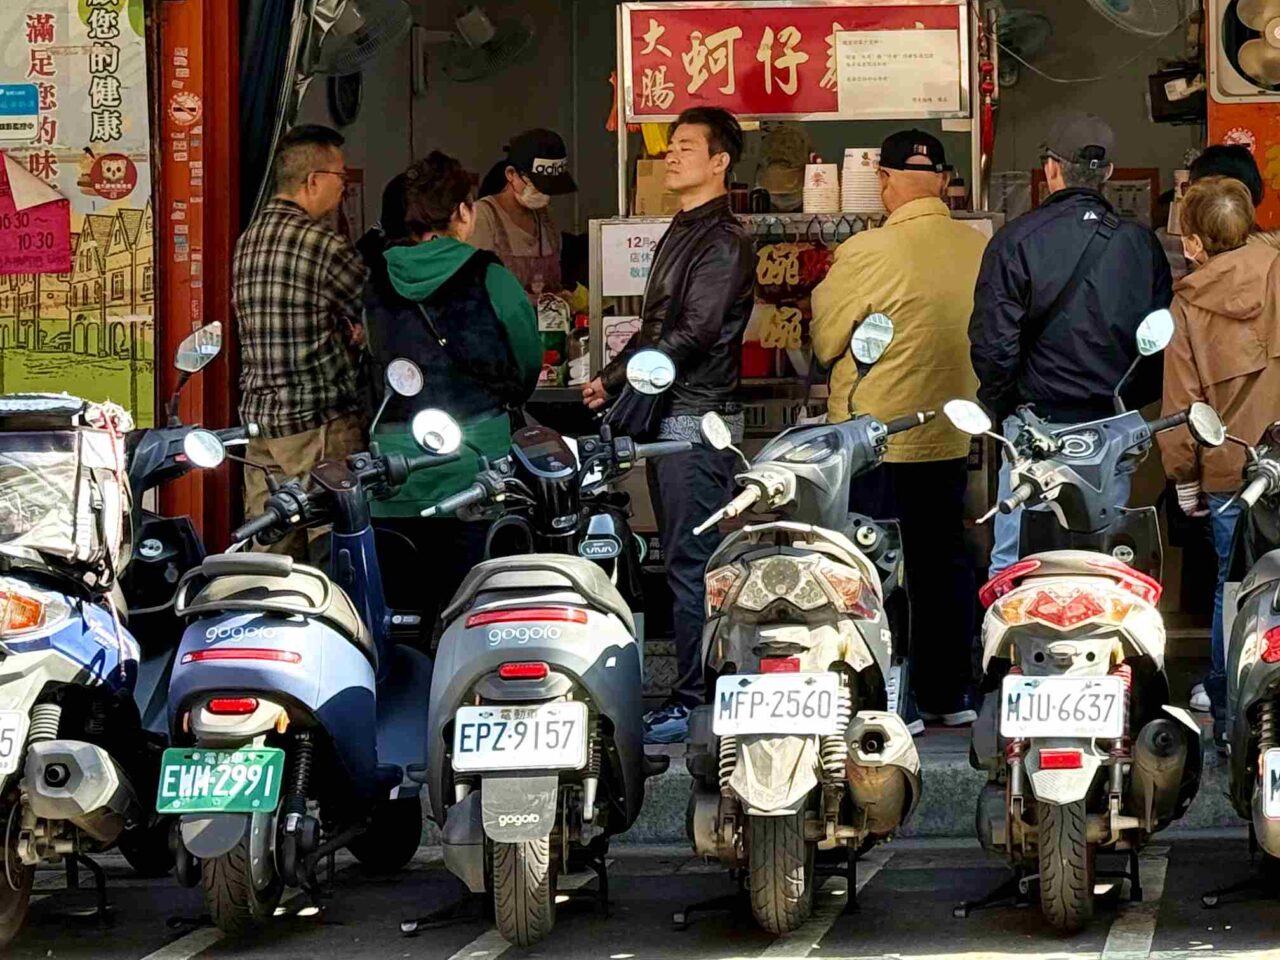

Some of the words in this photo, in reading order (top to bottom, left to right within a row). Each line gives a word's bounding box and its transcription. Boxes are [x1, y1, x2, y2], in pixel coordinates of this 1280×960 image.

[640, 18, 675, 110] 大腸
[26, 13, 59, 192] 滿足您的味
[205, 625, 276, 643] gogoro
[488, 624, 561, 646] gogoro
